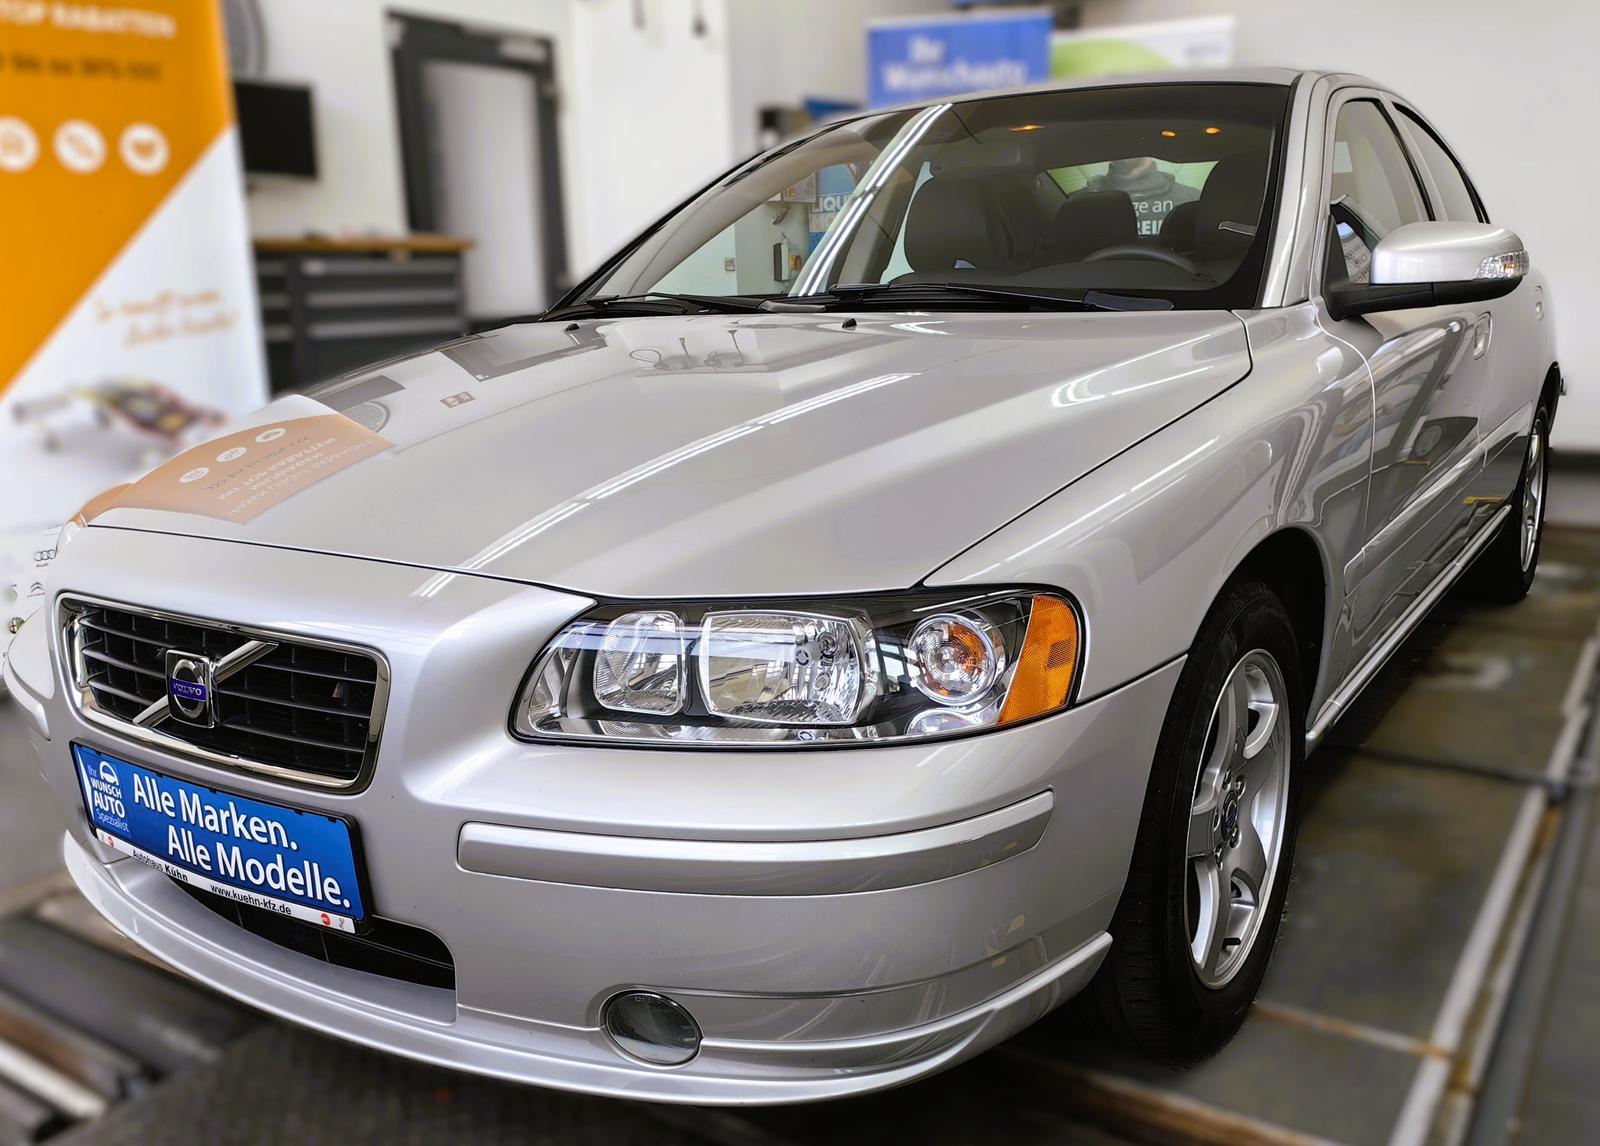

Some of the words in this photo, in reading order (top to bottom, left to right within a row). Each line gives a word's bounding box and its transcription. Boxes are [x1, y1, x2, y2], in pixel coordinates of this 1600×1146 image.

[1152, 200, 1173, 213] an
[174, 683, 202, 696] VOLVO
[90, 776, 122, 799] WUNSCH
[94, 790, 126, 819] AUTO
[133, 772, 176, 818] Alle
[178, 788, 298, 851] Marken.
[132, 848, 164, 872] Autohaus
[164, 862, 189, 883] Kühn
[167, 824, 212, 871] Alle
[215, 841, 351, 909] Modelle.
[210, 883, 292, 915] www.kuehn-kfz.de
